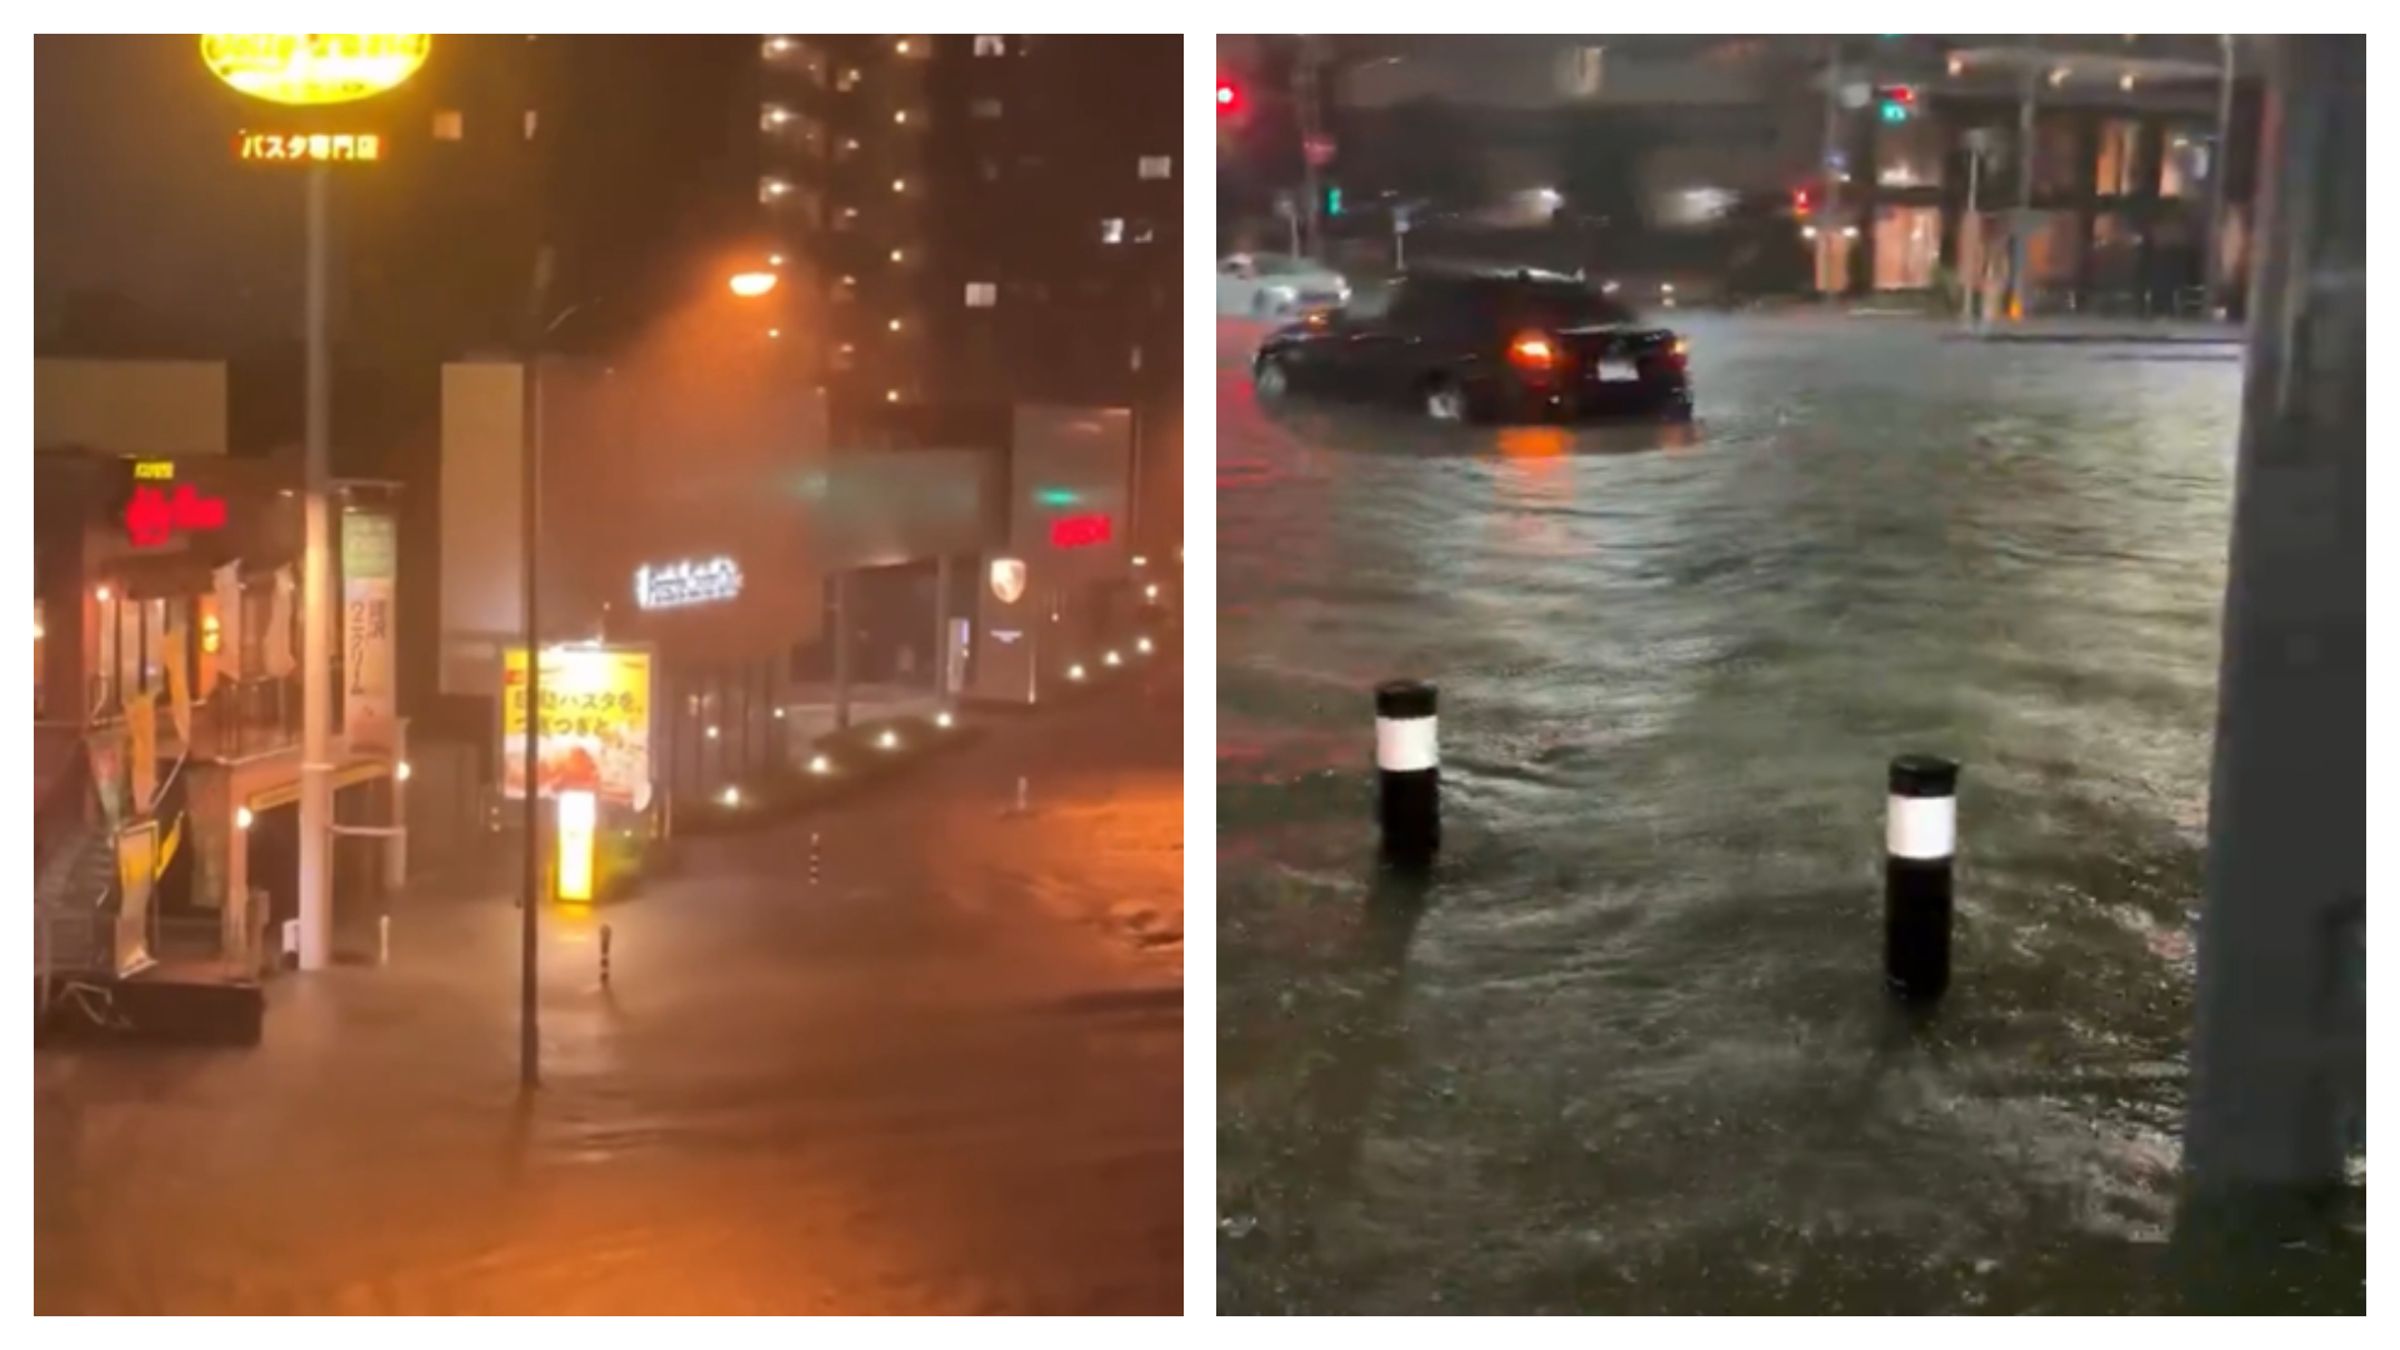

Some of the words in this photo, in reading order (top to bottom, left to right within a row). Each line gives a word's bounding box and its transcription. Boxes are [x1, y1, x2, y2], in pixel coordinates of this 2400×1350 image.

[239, 131, 379, 160] パスタ専門店
